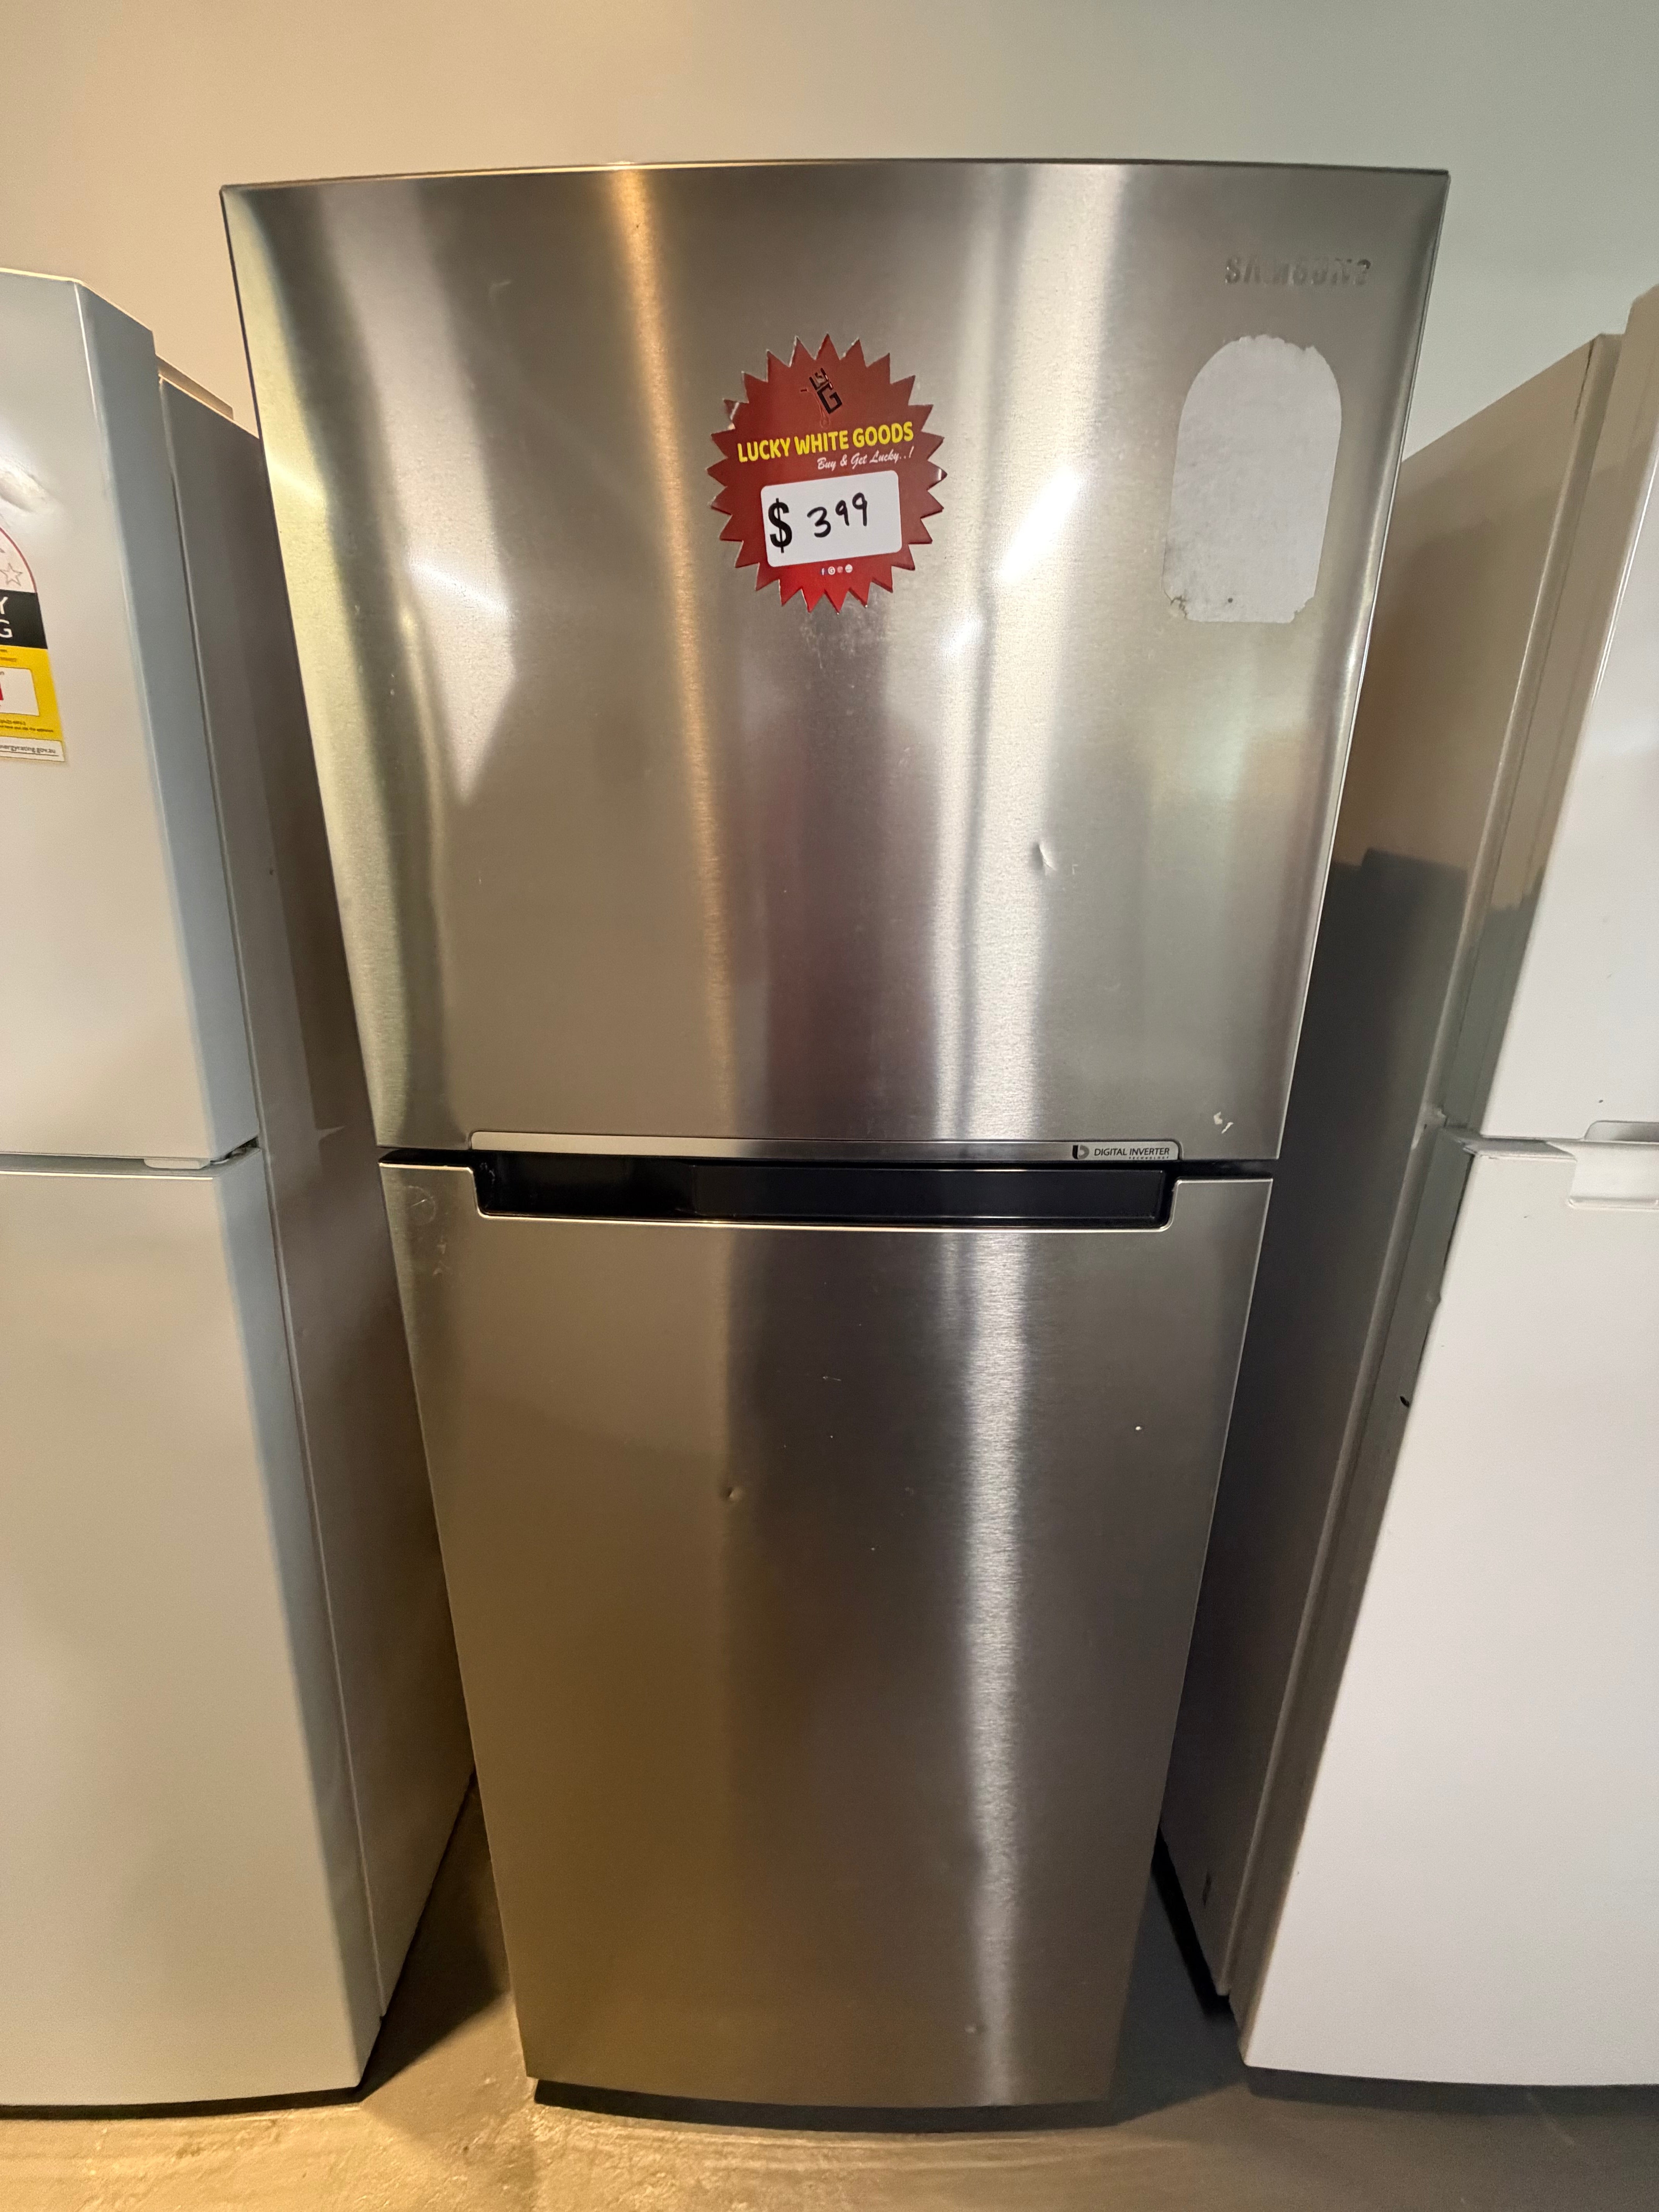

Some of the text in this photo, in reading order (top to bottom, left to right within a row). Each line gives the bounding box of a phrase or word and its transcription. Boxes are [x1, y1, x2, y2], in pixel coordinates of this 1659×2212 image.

[737, 421, 914, 462] LUCKY WHITE GOODS
[817, 457, 836, 471] Buy
[840, 454, 848, 467] &
[850, 452, 868, 469] Get
[807, 492, 868, 538] 399
[1094, 1147, 1170, 1156] DIGITAL INVERTER
